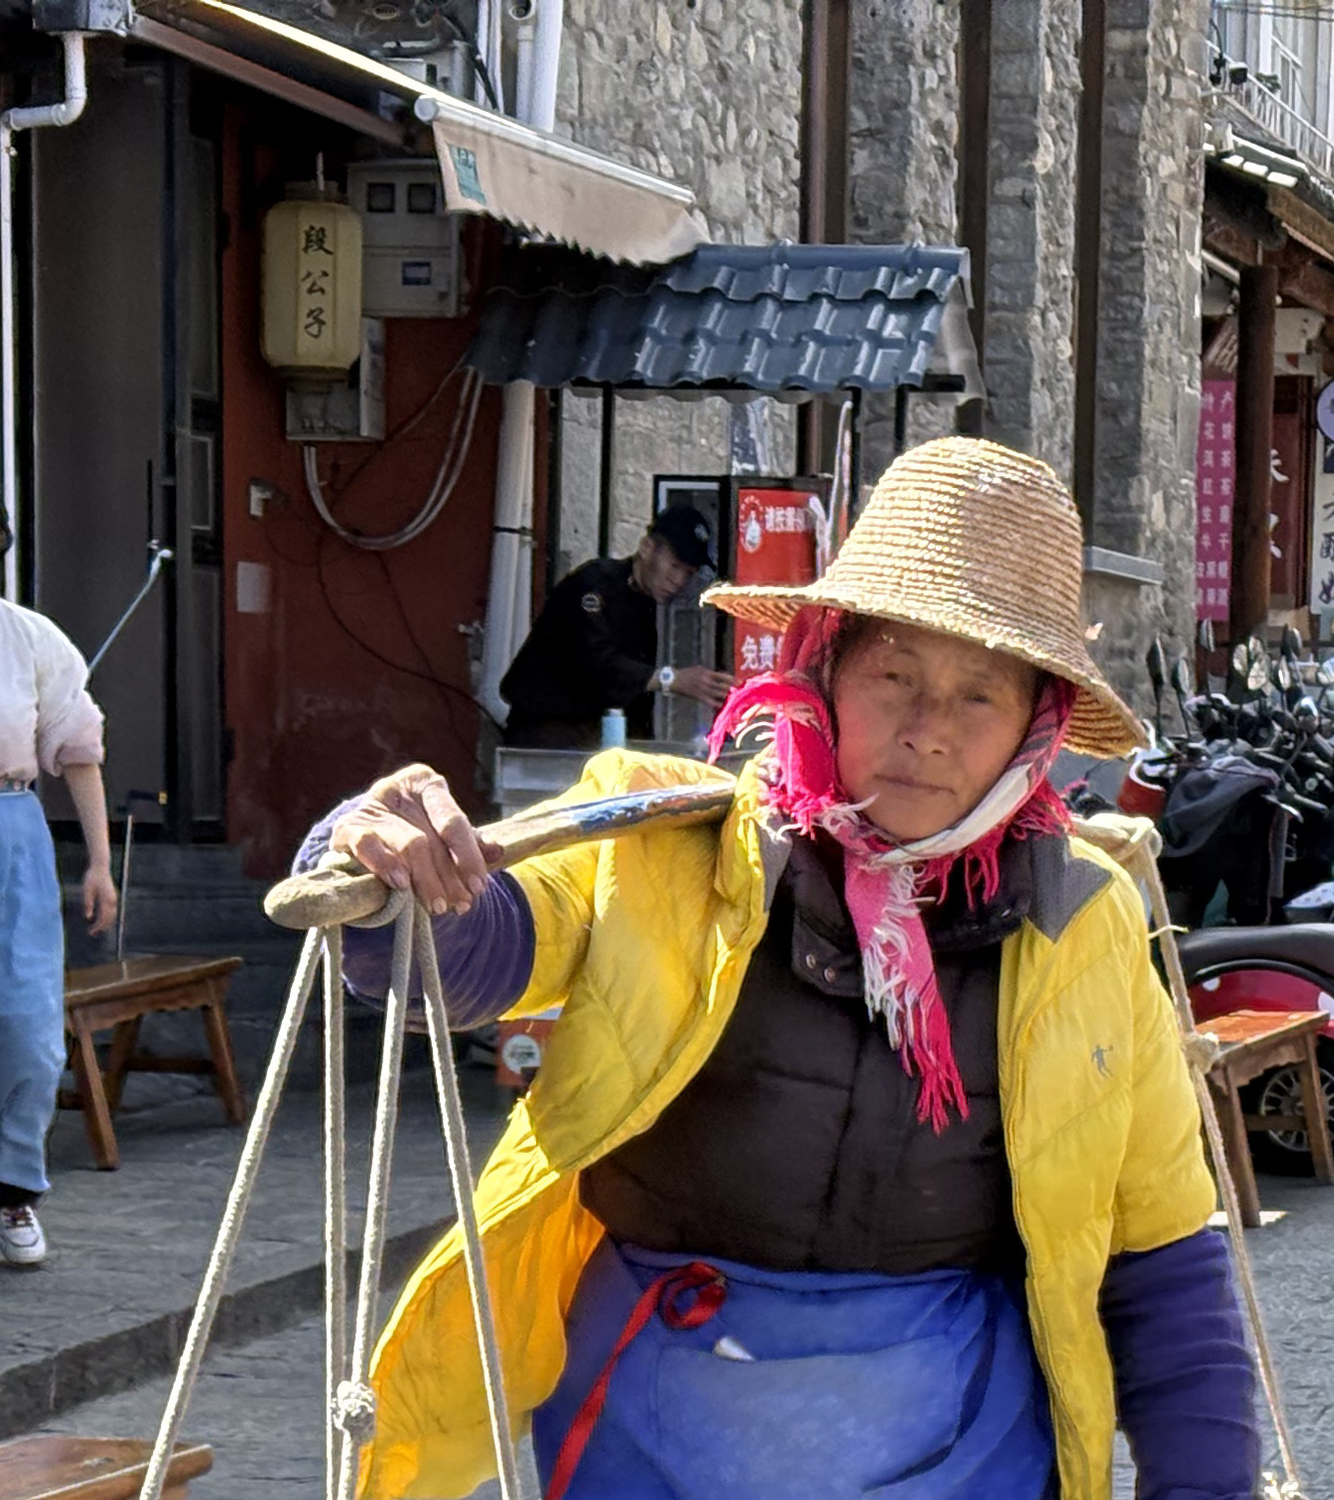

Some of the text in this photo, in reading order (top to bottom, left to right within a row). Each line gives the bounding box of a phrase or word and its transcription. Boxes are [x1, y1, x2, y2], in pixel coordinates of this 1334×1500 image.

[301, 224, 334, 339] 段公子
[740, 634, 783, 671] 免费
